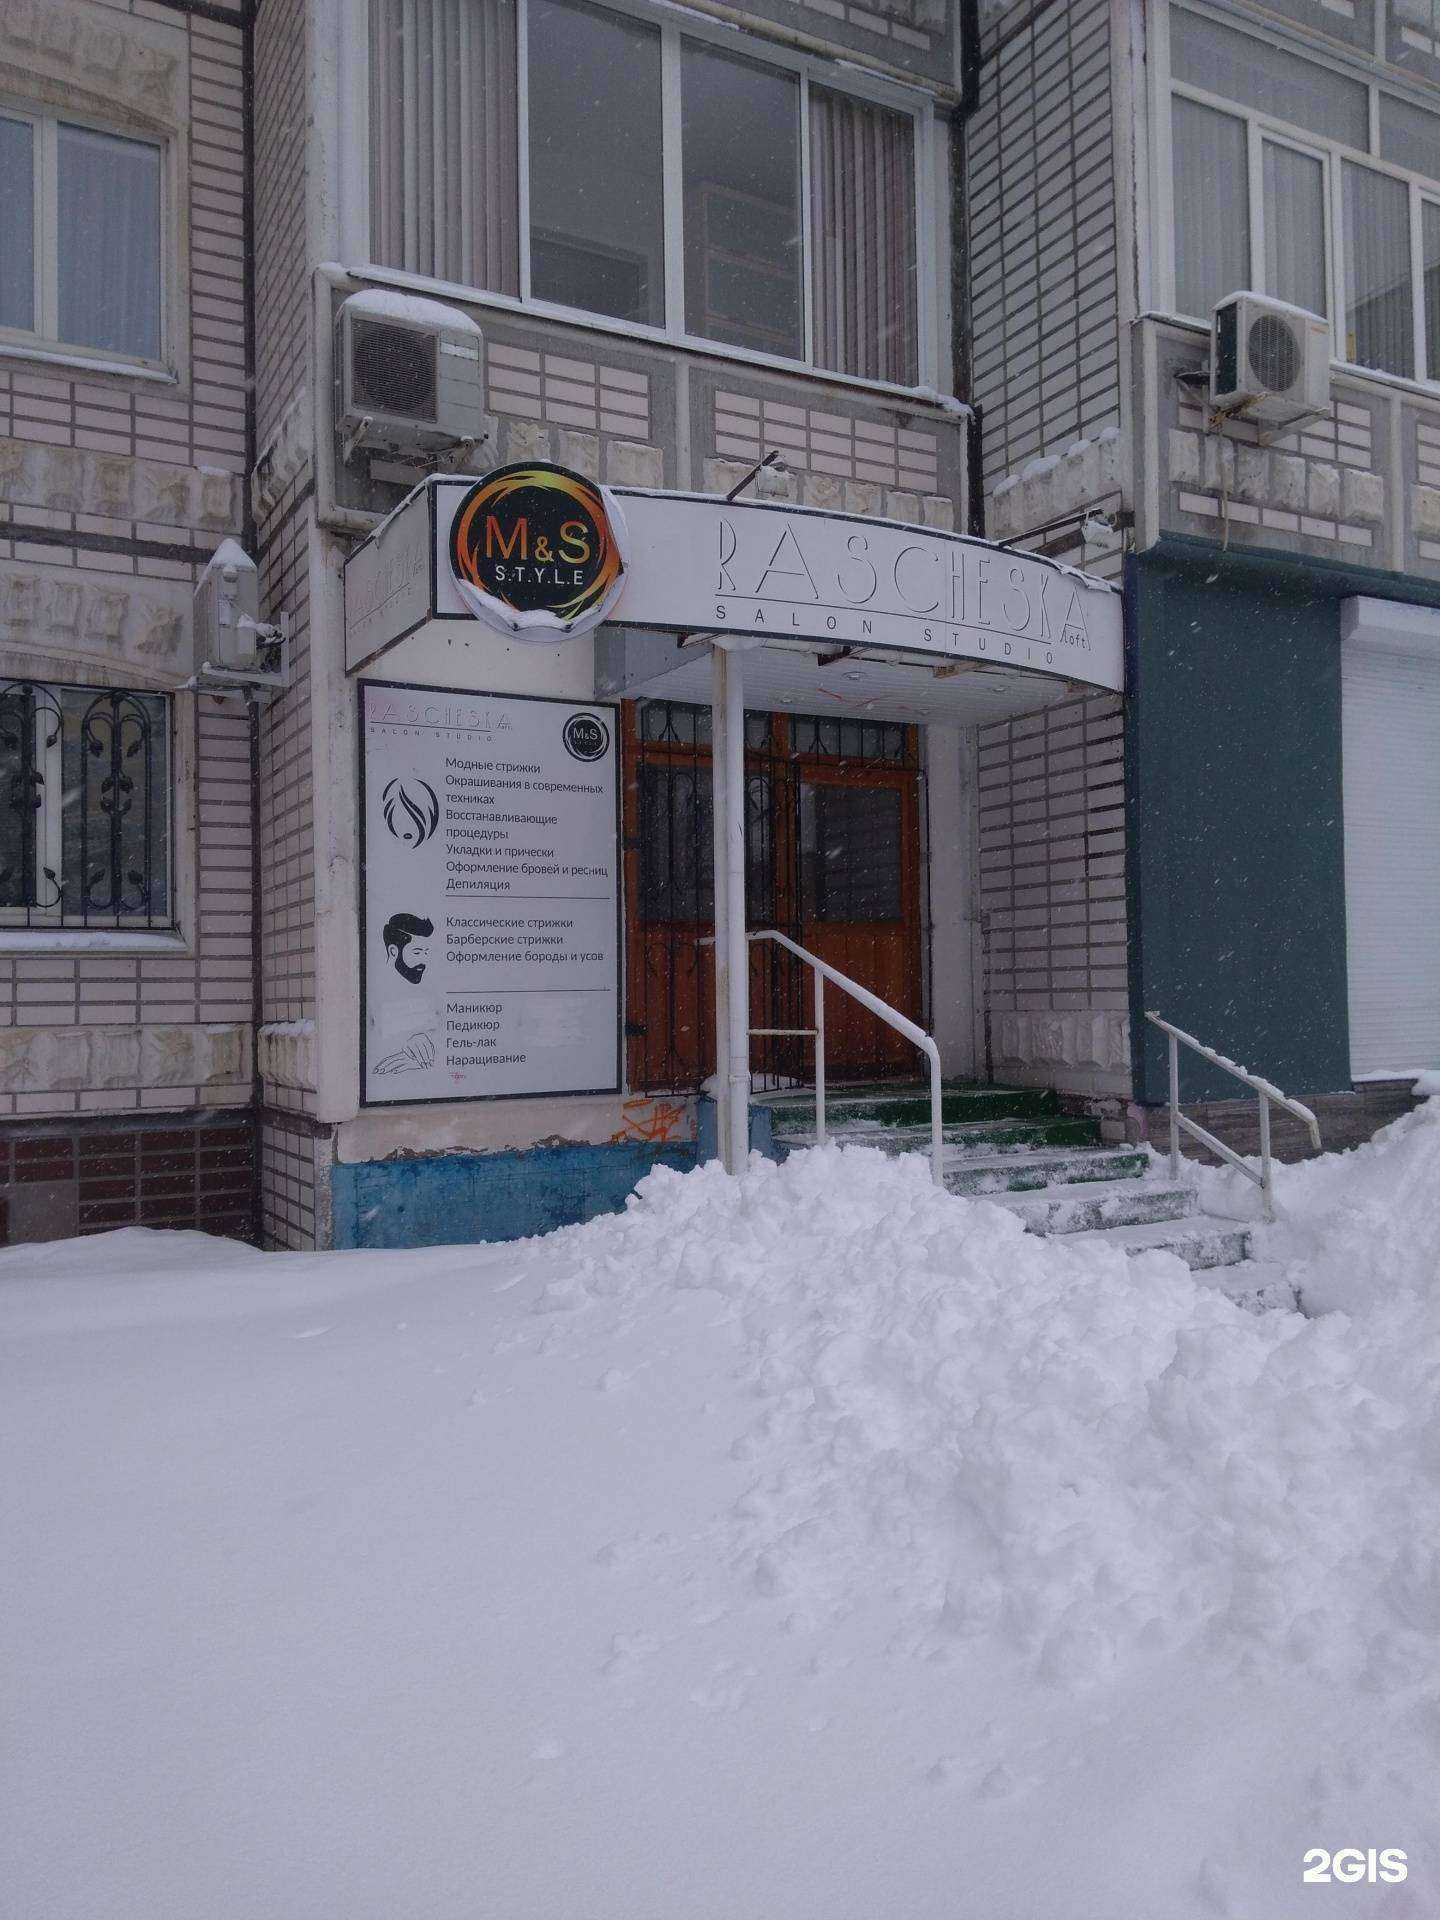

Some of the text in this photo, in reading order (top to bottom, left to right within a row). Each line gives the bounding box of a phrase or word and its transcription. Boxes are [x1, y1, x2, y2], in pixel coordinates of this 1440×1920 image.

[486, 515, 591, 564] M&S
[717, 518, 1092, 652] RASCHESKA
[716, 605, 1054, 665] SALON STUDIO
[445, 757, 541, 774] Модные стрижки
[445, 775, 604, 794] Окрашивания в современных
[446, 794, 495, 805] техниках
[446, 809, 558, 825] Восстанавливающие
[446, 828, 509, 840] процедуры
[446, 844, 554, 859] Укладки и прически
[446, 861, 609, 878] Оформление бровей и ресниц
[446, 878, 511, 891] Депиляция
[446, 916, 574, 930] Классические стрижки
[446, 934, 564, 946] Барберские стрижки
[446, 950, 604, 963] Оформление бороды и усов
[446, 1003, 503, 1015] Маникюр
[446, 1020, 500, 1032] Педикюр
[446, 1037, 497, 1049] Гель-лак
[446, 1054, 527, 1067] Наращивание
